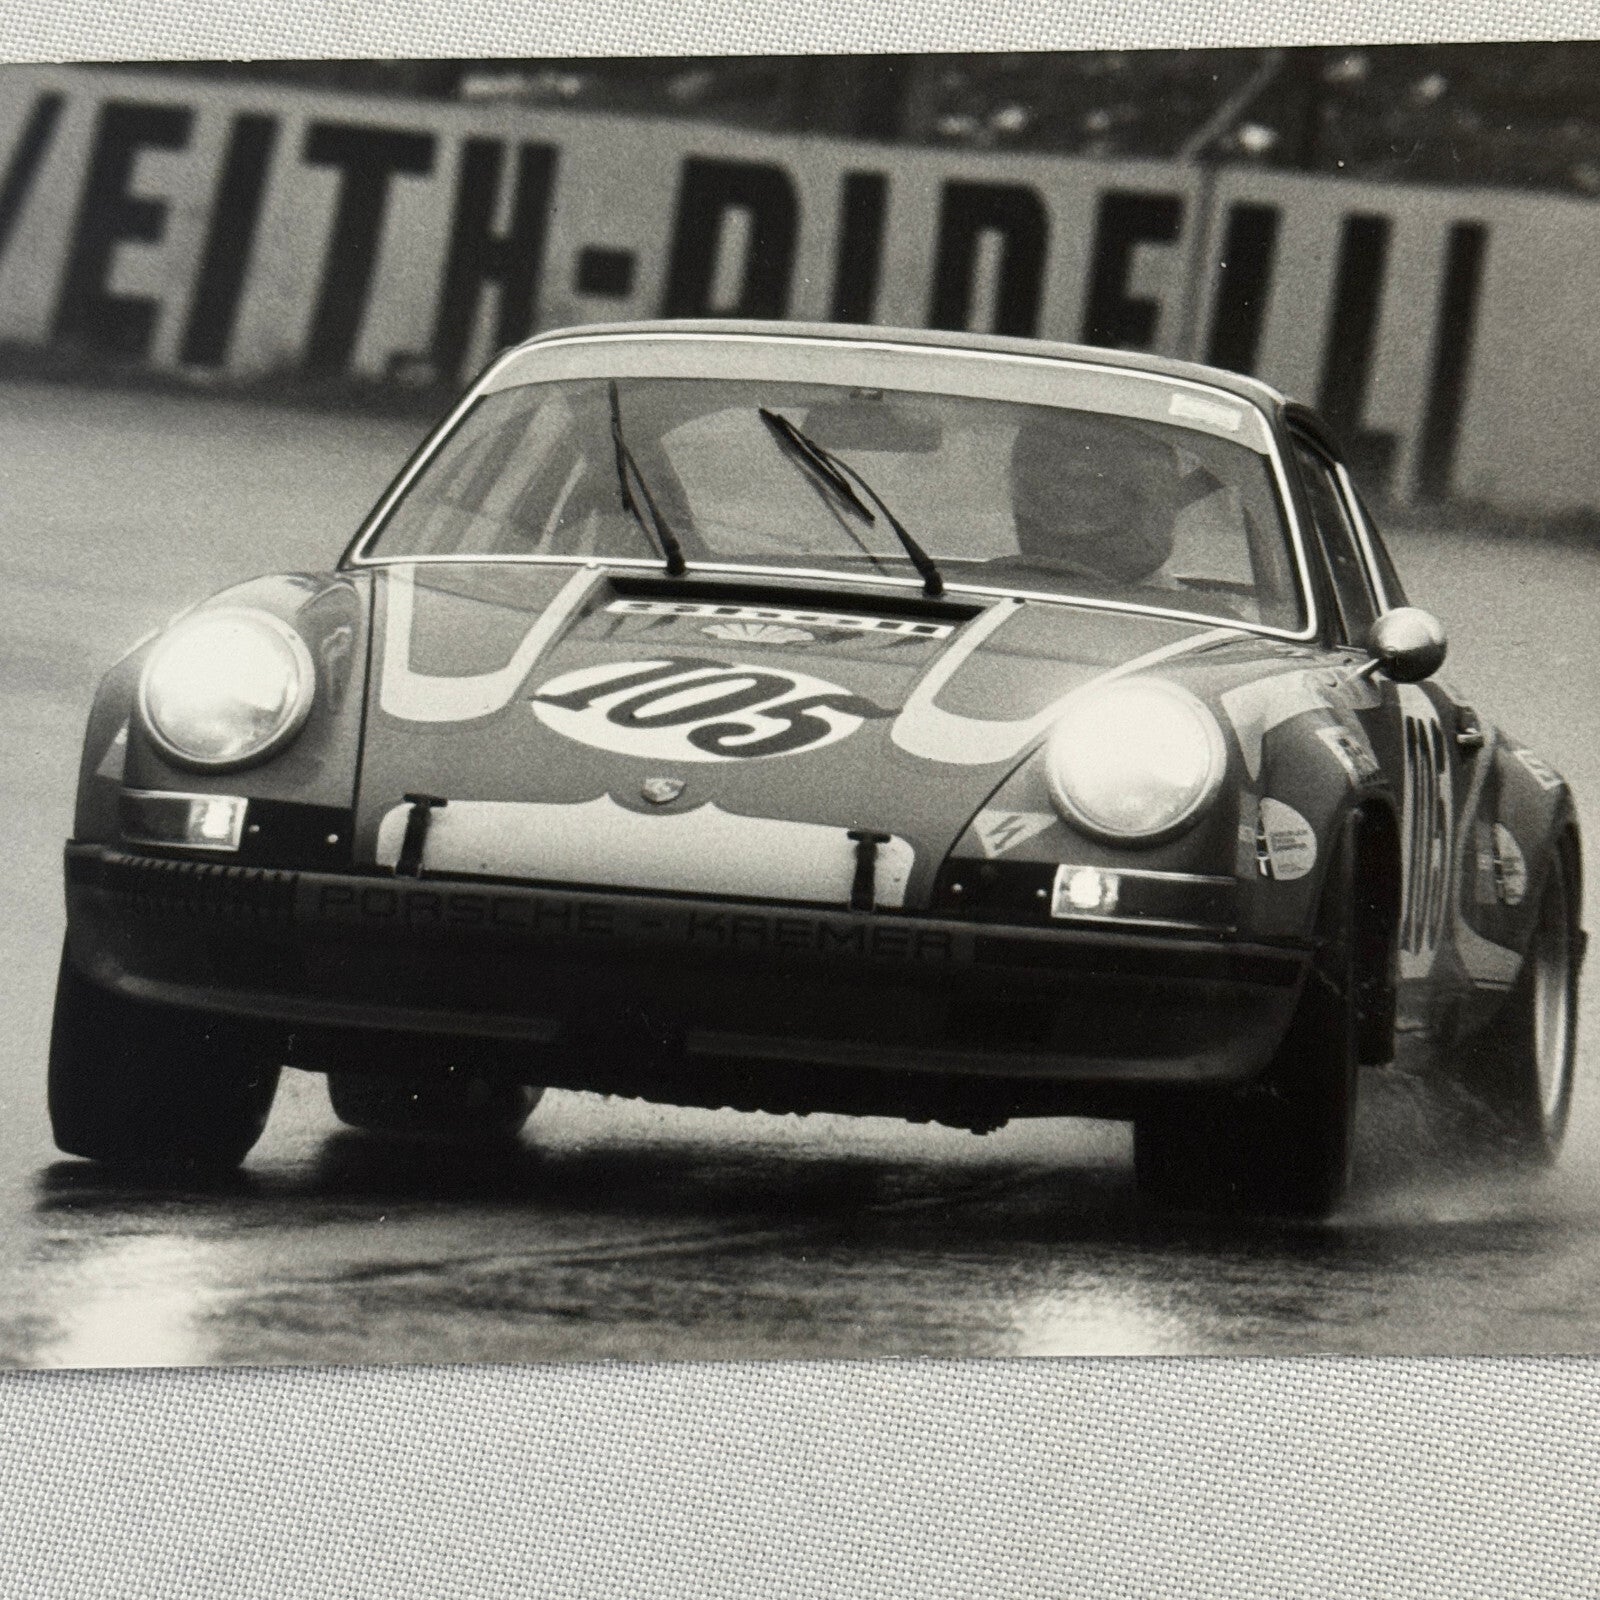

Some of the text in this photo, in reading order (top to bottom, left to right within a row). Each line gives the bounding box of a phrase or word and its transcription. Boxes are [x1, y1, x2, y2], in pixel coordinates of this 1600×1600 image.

[529, 656, 902, 758] 105
[318, 884, 616, 934] PORSCHE
[688, 910, 953, 960] KREMER
